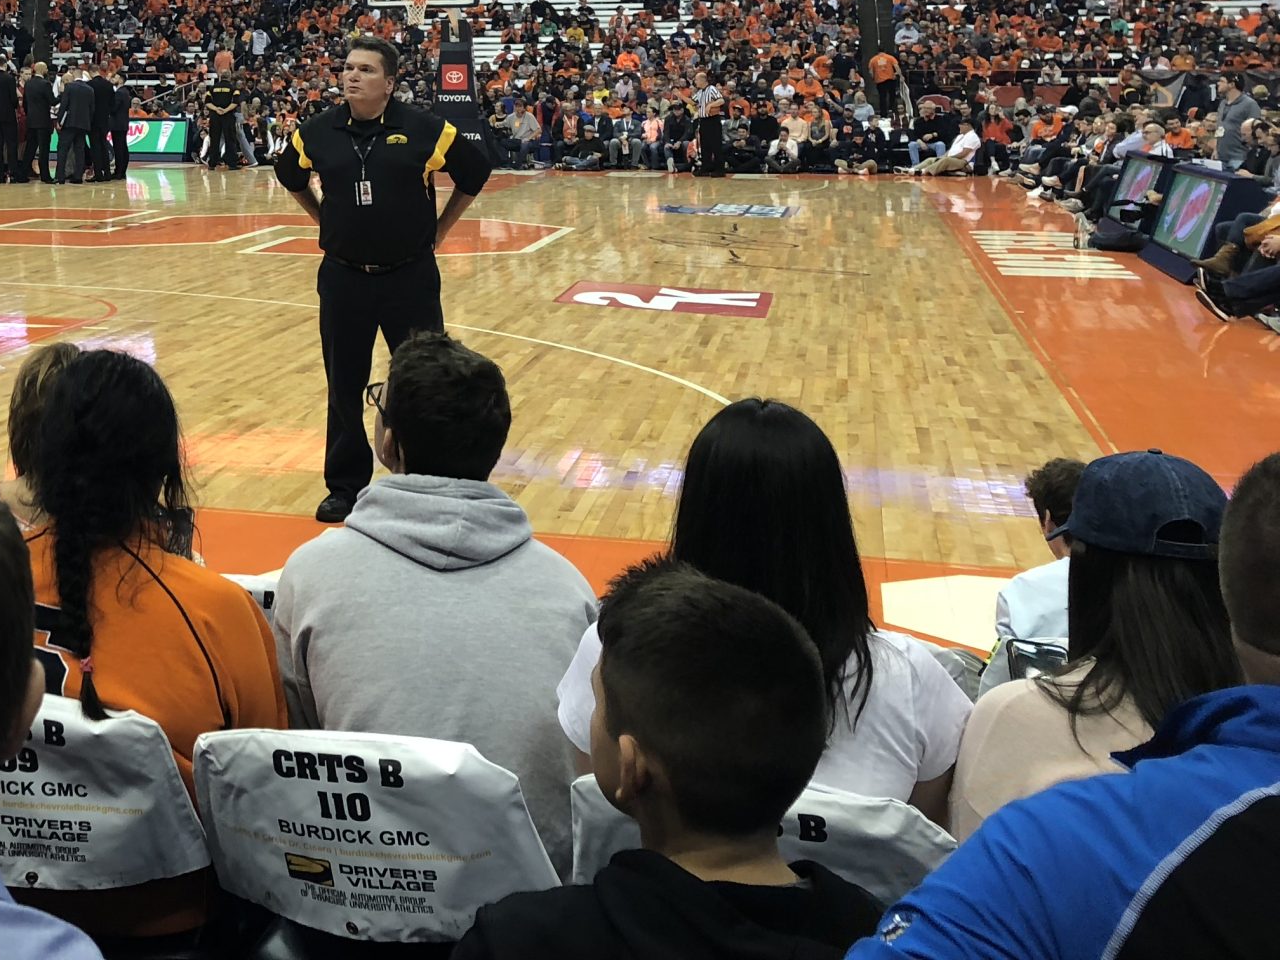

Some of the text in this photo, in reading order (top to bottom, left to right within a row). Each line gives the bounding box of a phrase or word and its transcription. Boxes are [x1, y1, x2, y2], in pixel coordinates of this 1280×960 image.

[43, 719, 66, 747] B
[272, 748, 405, 788] CRTS B
[41, 782, 88, 798] GMC
[317, 790, 372, 822] 110
[0, 814, 92, 832] DRIVER'S
[7, 826, 90, 843] VILLAGE
[278, 818, 374, 846] BURDICK
[379, 830, 431, 847] GMC
[799, 813, 828, 843] B
[339, 863, 438, 881] DRIVER'S
[346, 876, 436, 893] VILLAGE
